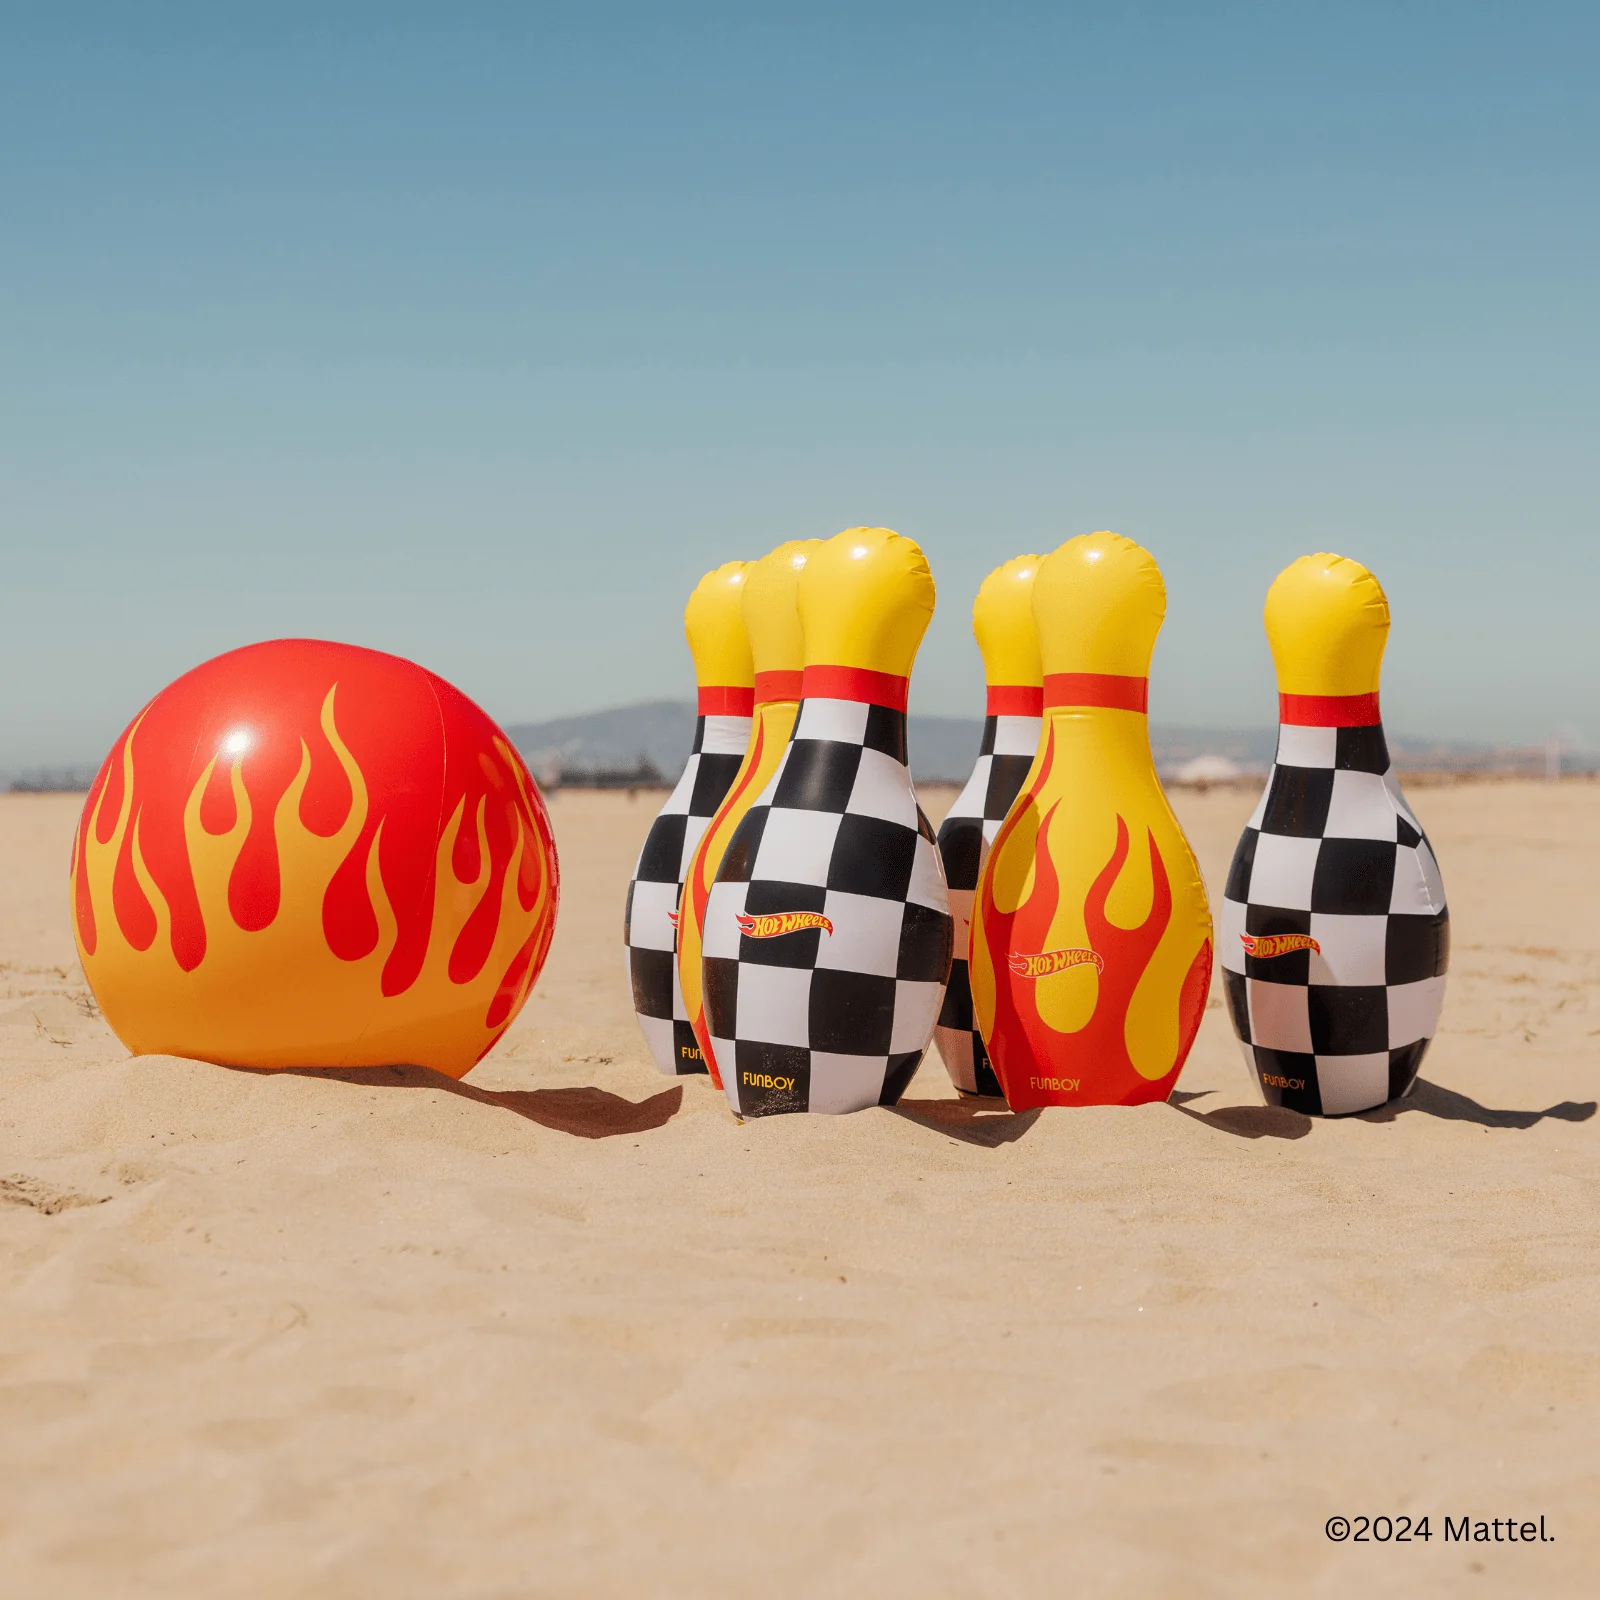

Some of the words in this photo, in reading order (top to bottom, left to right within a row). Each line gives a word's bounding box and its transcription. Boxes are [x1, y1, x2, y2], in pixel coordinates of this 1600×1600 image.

[751, 917, 781, 936] HOT
[1024, 957, 1053, 976] HOT
[681, 1047, 704, 1060] FUN
[743, 1072, 795, 1091] FUNBOY
[1030, 1077, 1081, 1092] FUNBOY
[1263, 1072, 1305, 1090] FUNBOY
